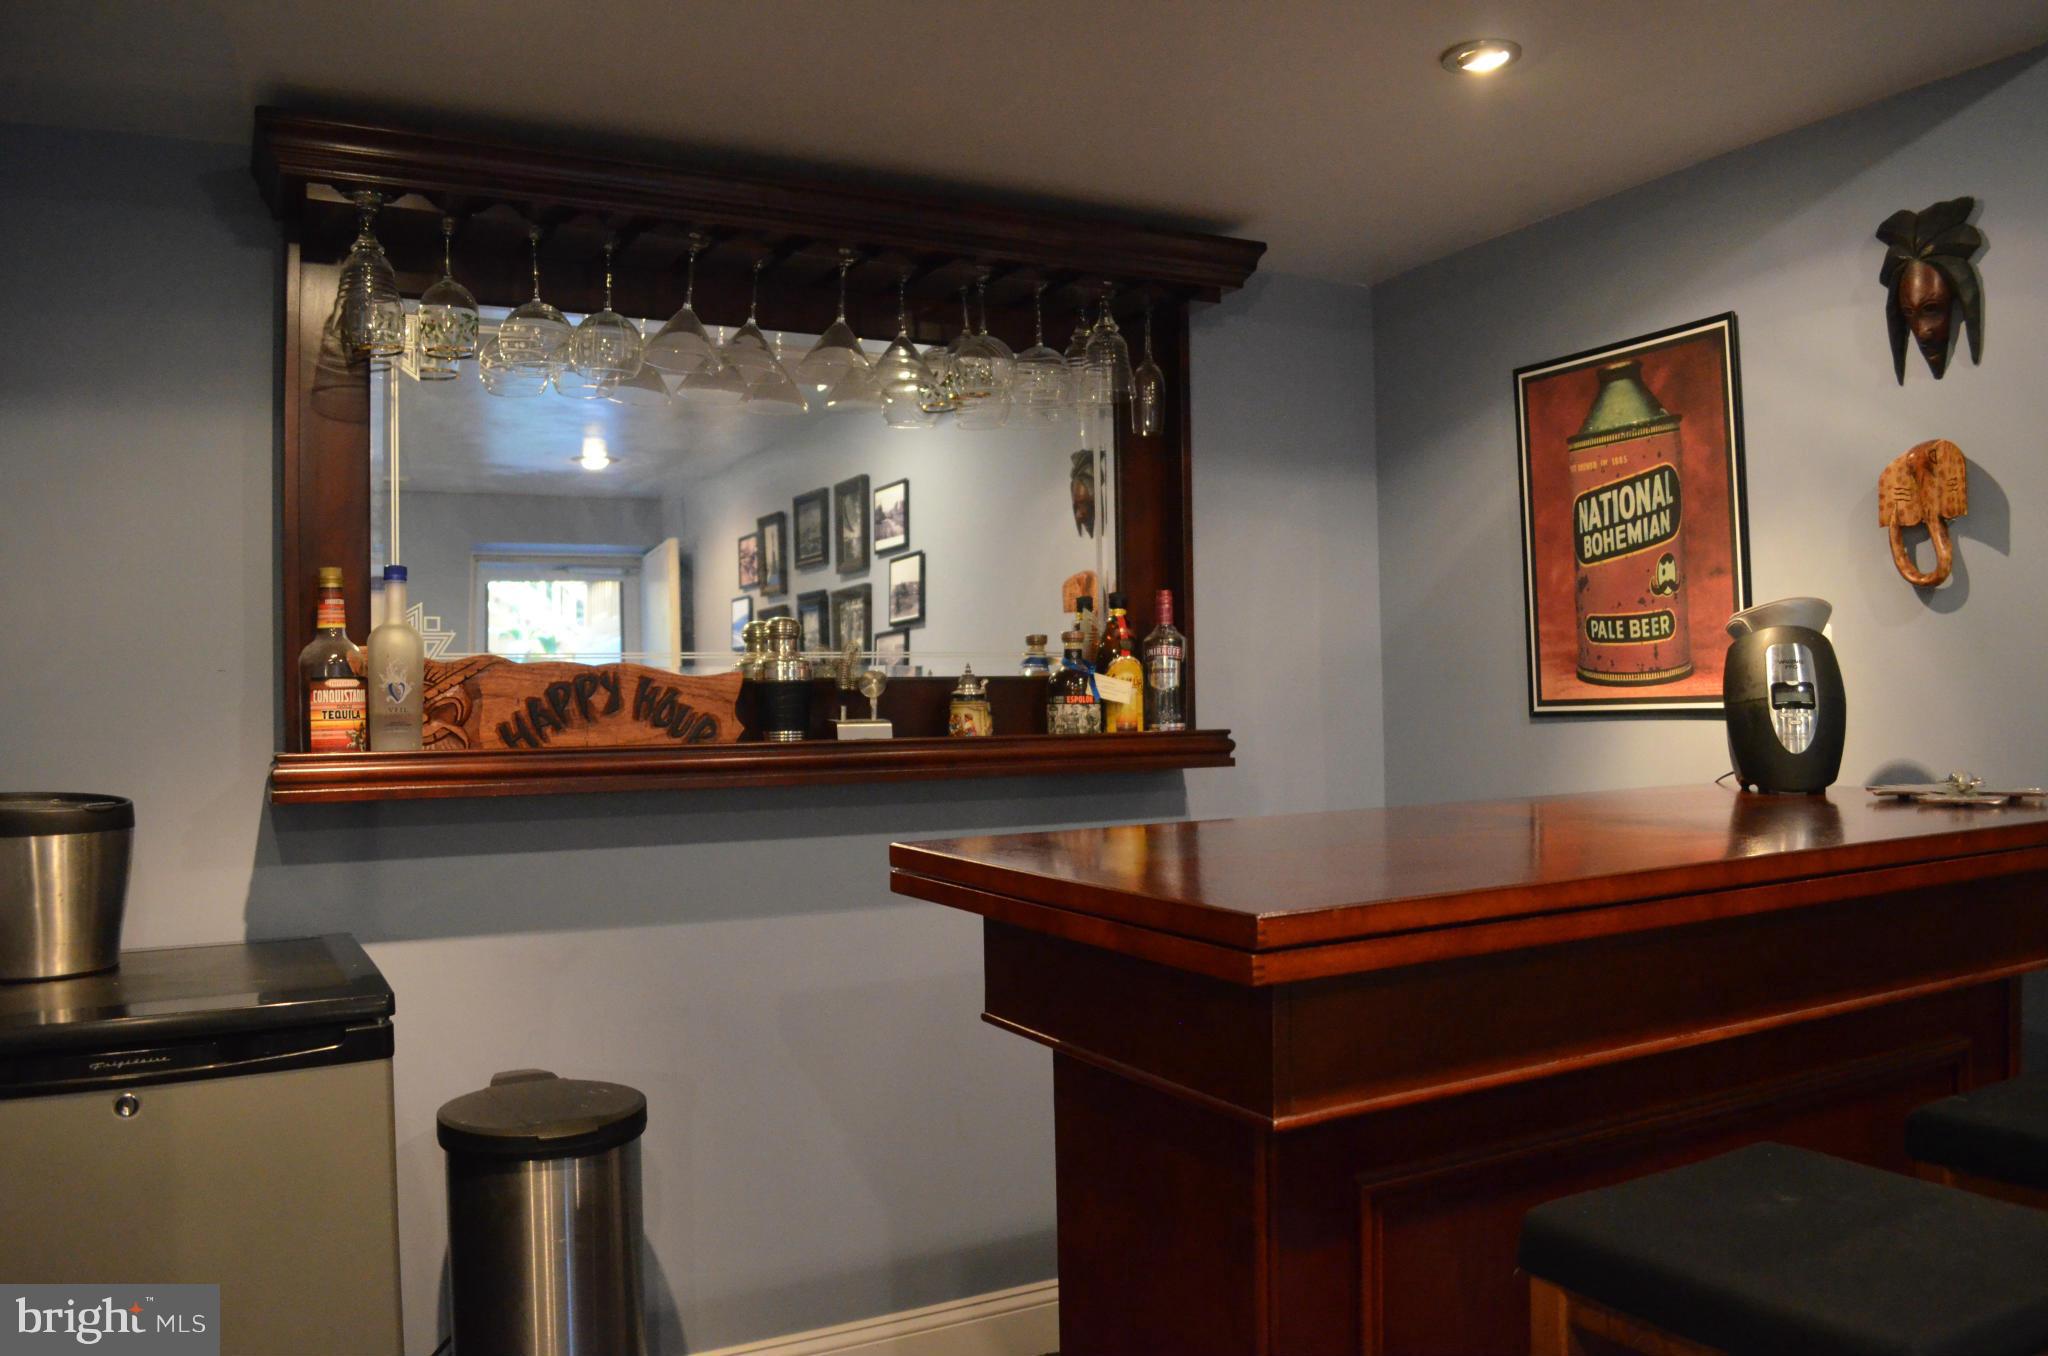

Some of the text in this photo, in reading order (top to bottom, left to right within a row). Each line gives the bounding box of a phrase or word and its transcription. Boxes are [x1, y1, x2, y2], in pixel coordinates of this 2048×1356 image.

[1578, 470, 1674, 534] NATIONAL
[1583, 508, 1671, 559] BOHEMIAN
[1590, 614, 1671, 639] PALE BEER
[313, 688, 366, 703] CONQUISTADO
[321, 709, 361, 720] TEQUILA
[495, 670, 625, 748] HAPPY
